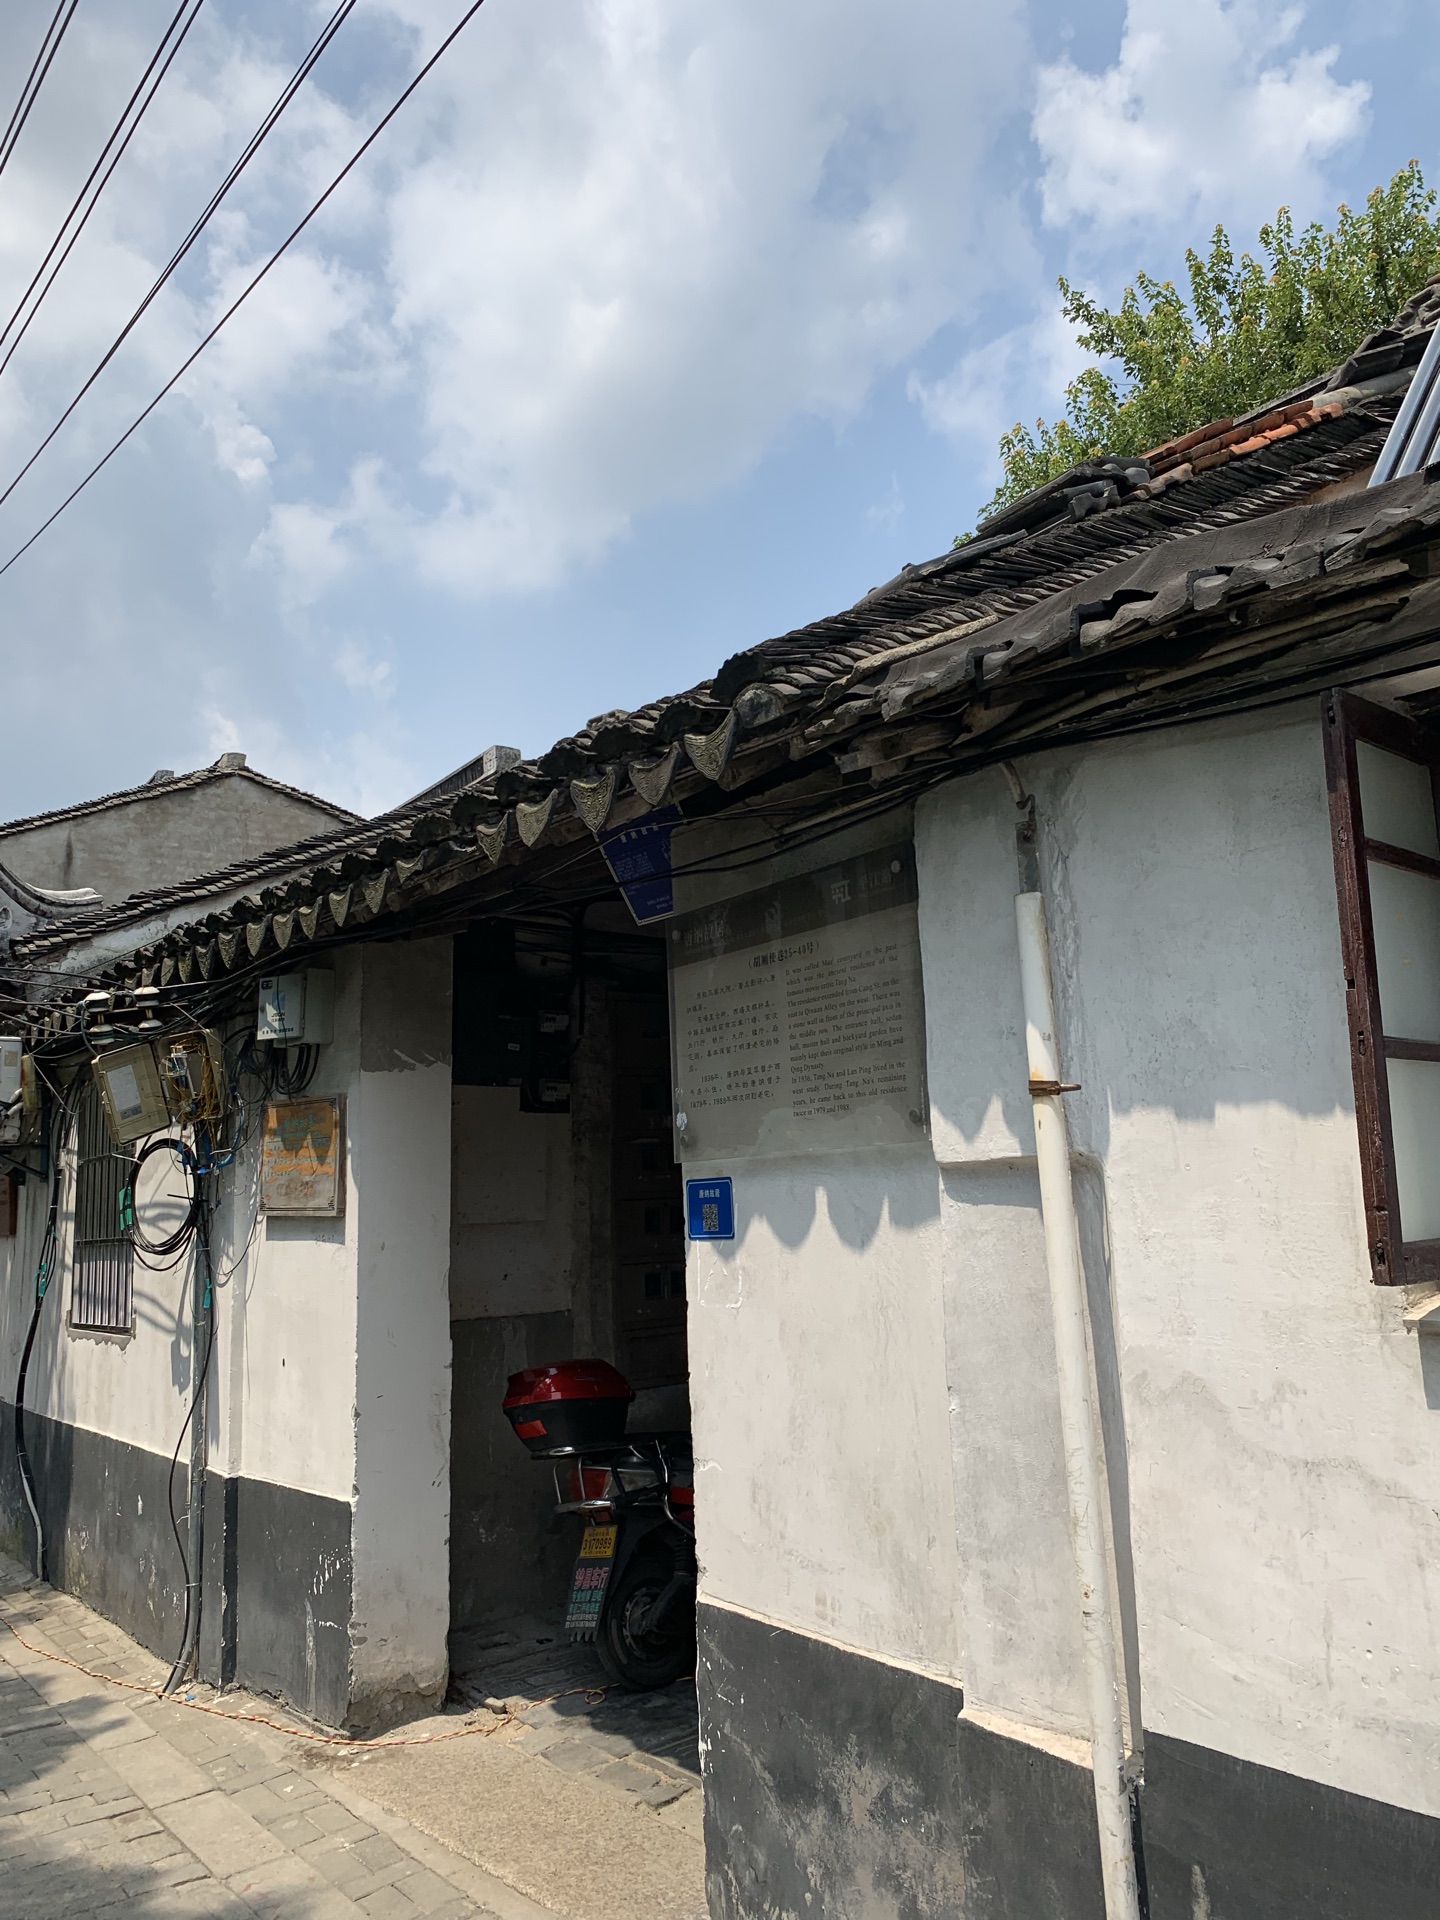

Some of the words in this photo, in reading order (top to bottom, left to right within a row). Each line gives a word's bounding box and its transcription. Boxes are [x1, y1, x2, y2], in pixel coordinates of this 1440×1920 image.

[804, 963, 819, 971] called
[837, 952, 862, 963] courtyard
[886, 944, 897, 953] past
[828, 967, 846, 976] ancient
[850, 961, 875, 971] residence
[821, 981, 834, 989] critic
[797, 996, 820, 1005] residence
[822, 990, 844, 1000] extended
[859, 985, 872, 993] Cang
[856, 1005, 880, 1017] principal
[799, 1030, 816, 1038] middle
[845, 1020, 867, 1029] entrance
[886, 1014, 901, 1022] sedan
[802, 1041, 818, 1049] master
[843, 1032, 867, 1042] backyard
[869, 1029, 887, 1038] garden
[790, 1054, 806, 1062] mainly
[833, 1045, 854, 1055] original
[855, 1043, 868, 1053] style
[877, 1040, 891, 1048] Ming
[791, 1066, 803, 1074] Qing
[873, 1063, 887, 1072] lived
[878, 1074, 906, 1083] remaining
[880, 1086, 907, 1094] residence
[814, 1107, 825, 1115] 1979
[583, 1537, 612, 1550] 3170989
